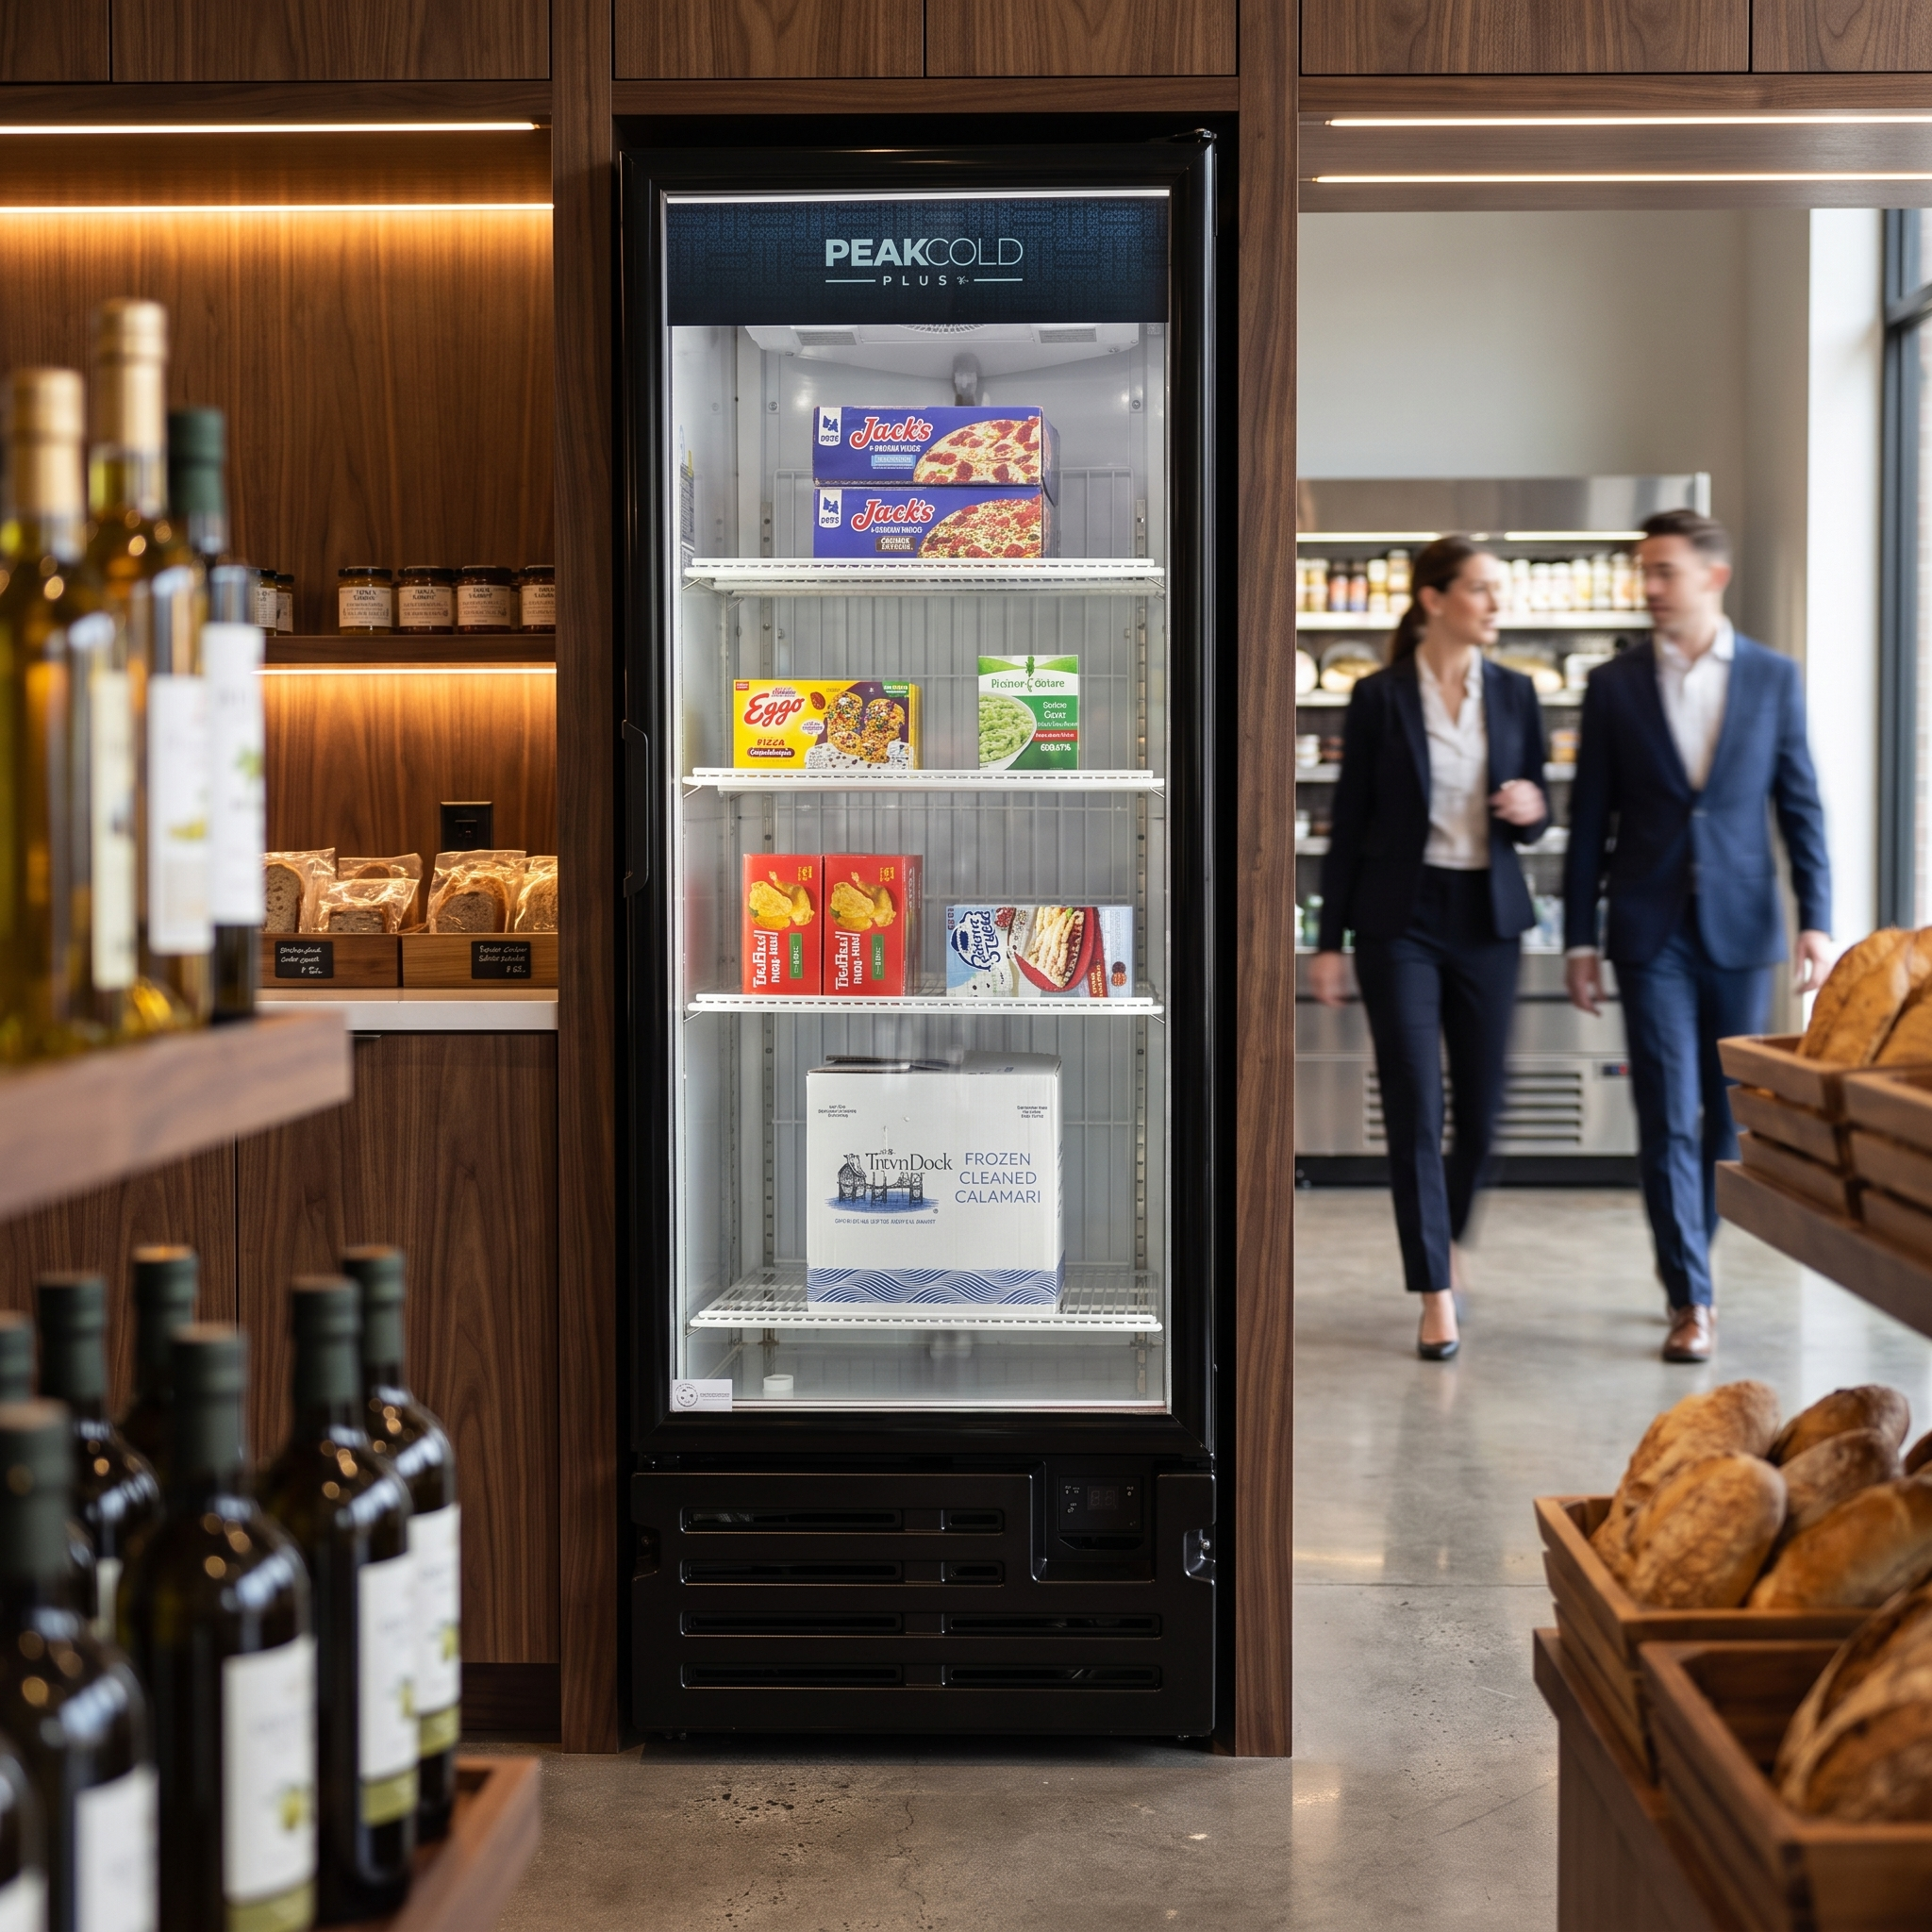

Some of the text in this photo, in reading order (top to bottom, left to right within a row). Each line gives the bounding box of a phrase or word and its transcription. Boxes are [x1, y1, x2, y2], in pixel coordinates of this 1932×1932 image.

[825, 238, 1024, 267] PEAKCOLD
[883, 275, 947, 286] PLUS
[850, 416, 934, 450] Jack's
[851, 498, 936, 532] Jack's
[743, 692, 806, 727] Eggo
[964, 1152, 1031, 1166] FROZEN
[958, 1171, 1038, 1185] CLEANED
[954, 1189, 1041, 1204] CALAMARI
